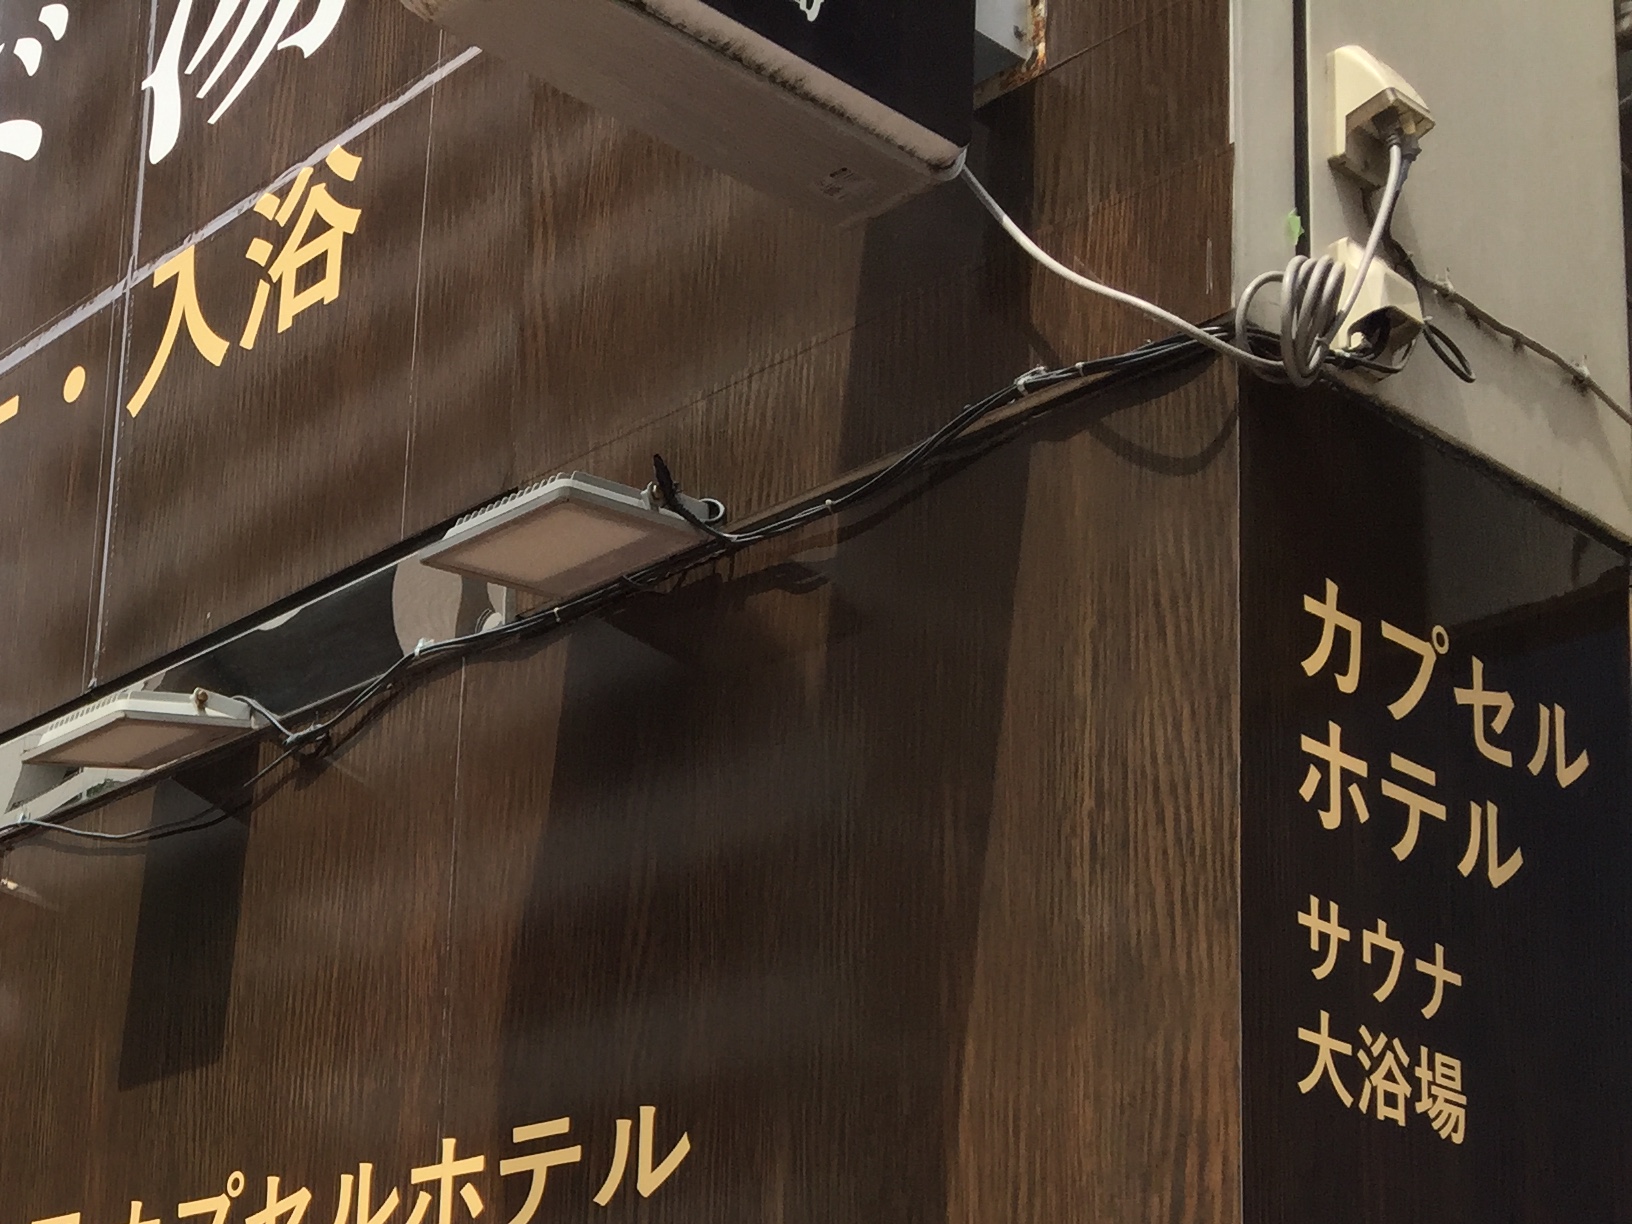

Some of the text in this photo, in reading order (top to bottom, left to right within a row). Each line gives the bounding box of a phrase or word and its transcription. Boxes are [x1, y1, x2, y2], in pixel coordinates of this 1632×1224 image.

[1298, 576, 1590, 789] カプセル
[1298, 720, 1524, 889] ホテル
[1297, 894, 1462, 1020] サウナ
[1297, 1010, 1468, 1146] 大浴場
